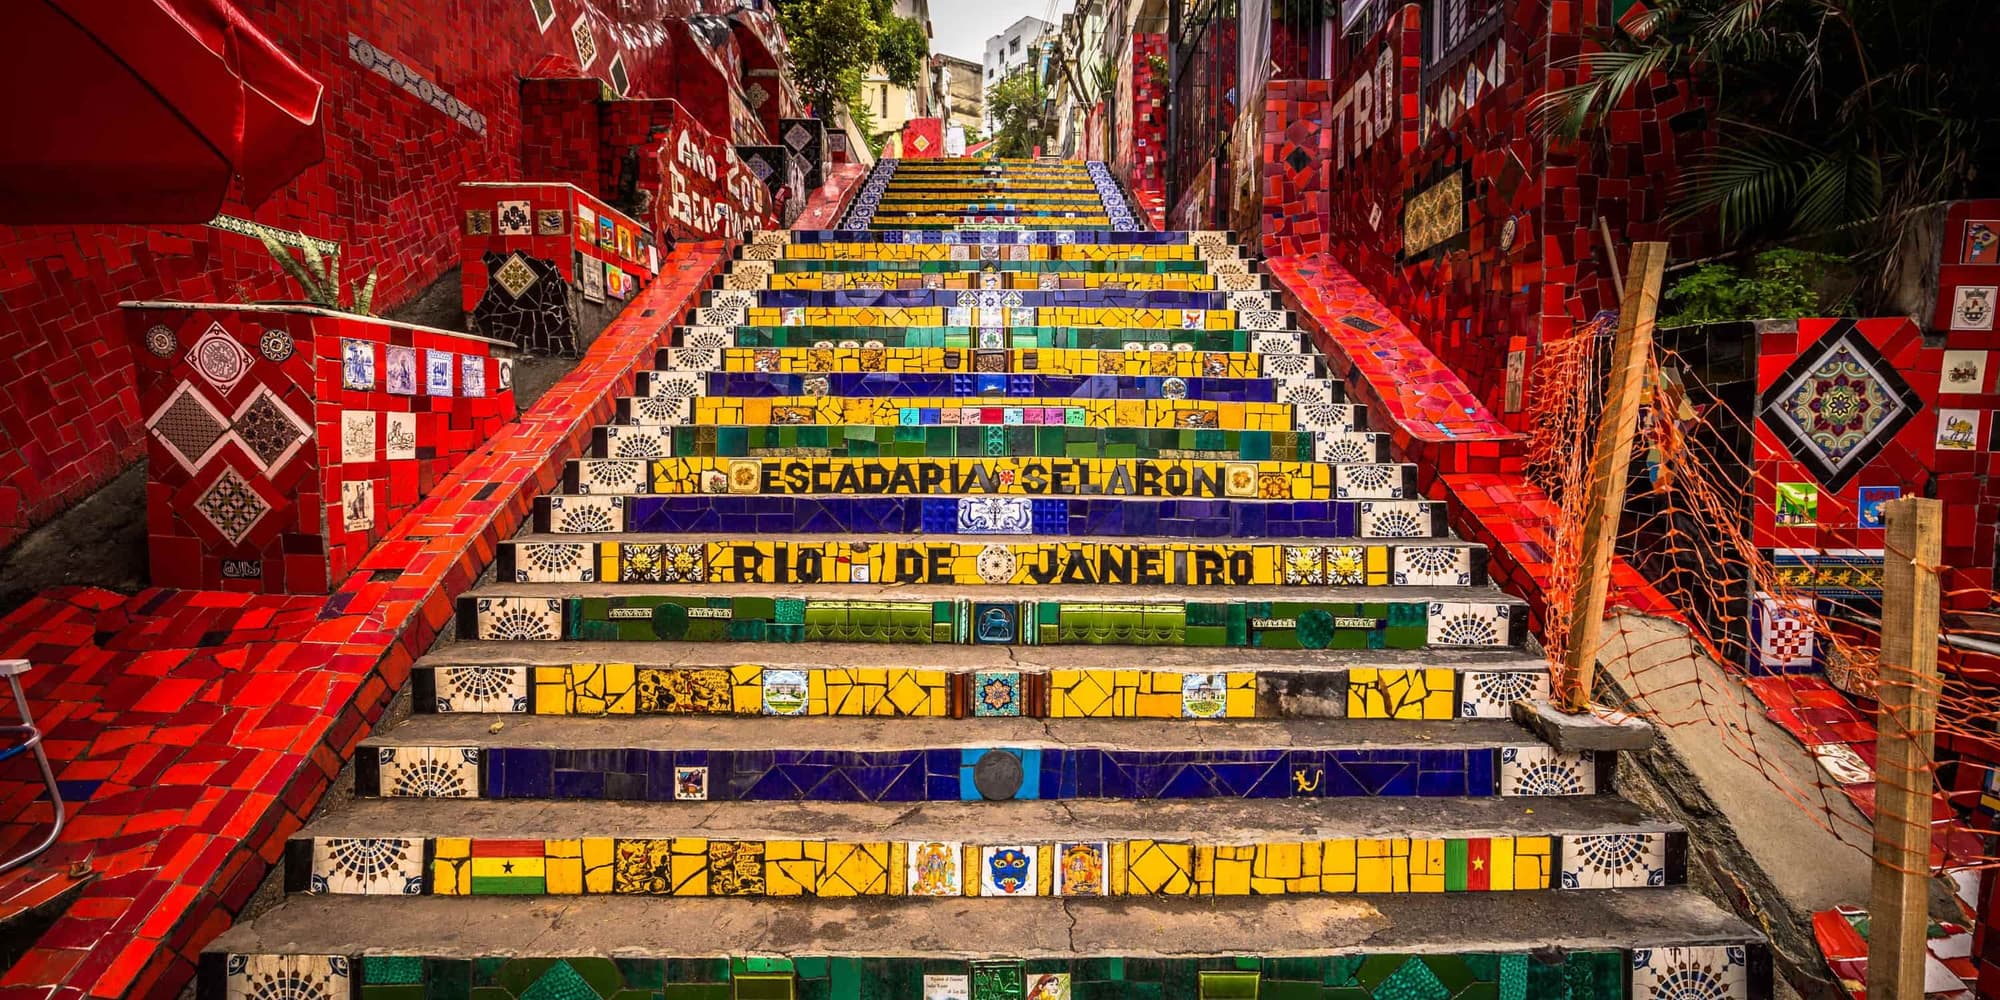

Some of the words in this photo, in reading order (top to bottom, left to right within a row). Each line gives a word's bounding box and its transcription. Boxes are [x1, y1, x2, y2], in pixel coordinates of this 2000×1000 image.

[678, 130, 716, 182] ANO
[760, 462, 993, 493] ESCADARIA
[1021, 464, 1225, 496] SELARON
[733, 547, 822, 582] RIO
[897, 548, 955, 583] DE
[1030, 550, 1252, 584] JANEIRO
